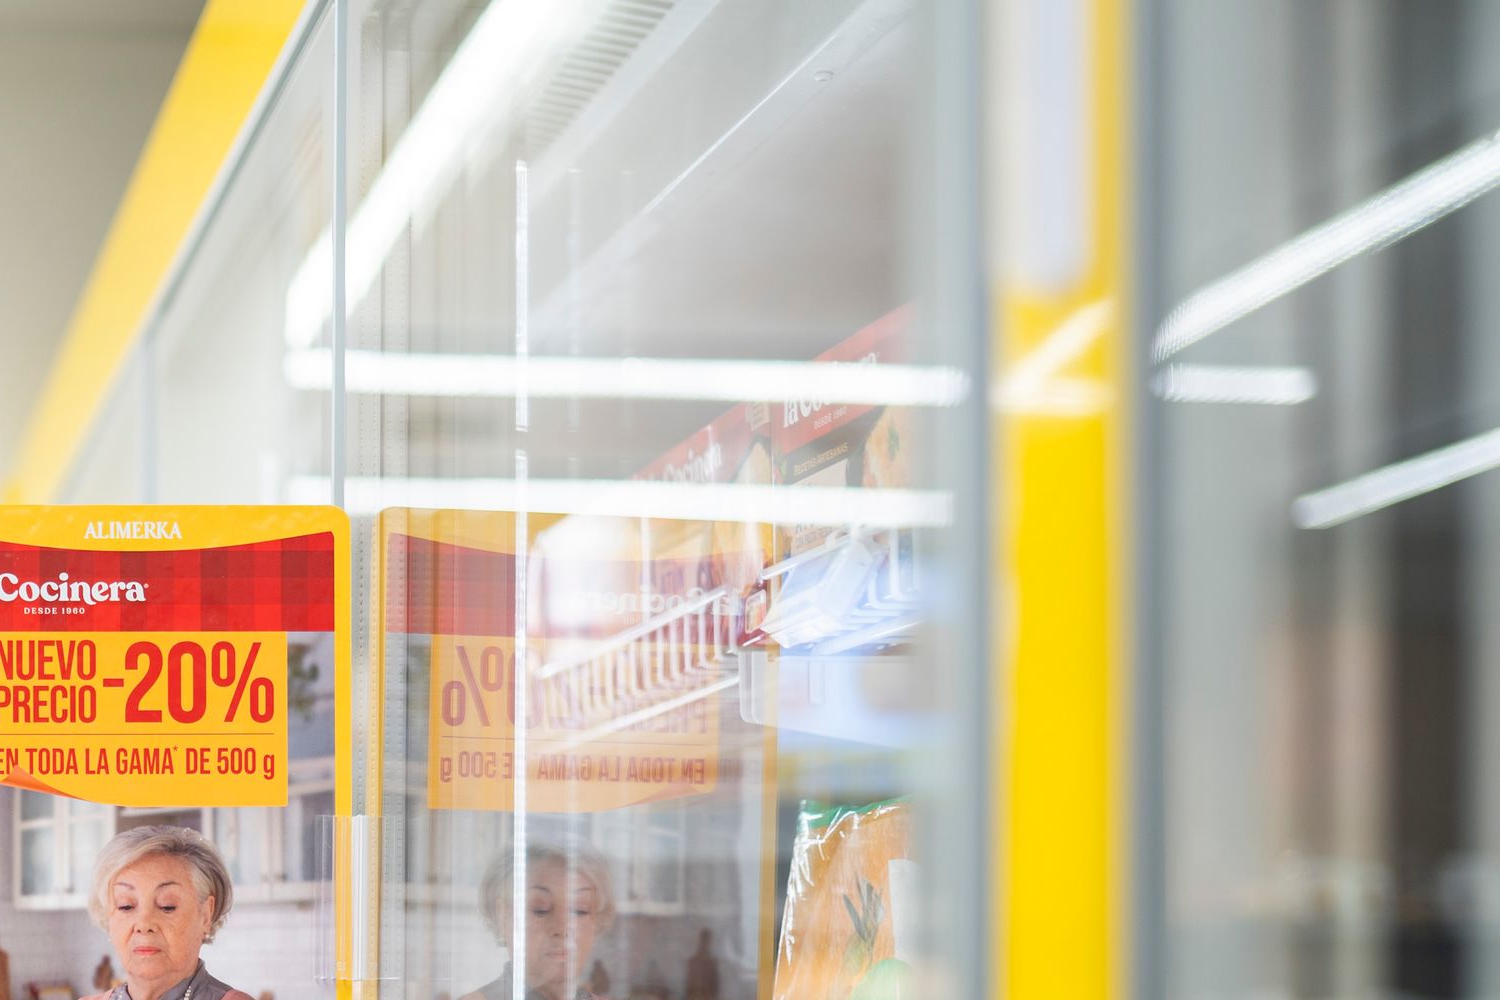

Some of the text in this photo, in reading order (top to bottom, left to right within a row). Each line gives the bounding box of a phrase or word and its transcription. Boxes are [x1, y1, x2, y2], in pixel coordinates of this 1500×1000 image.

[84, 521, 183, 540] ALIMERKA
[23, 607, 86, 615] DESDE 1960
[102, 640, 275, 724] -20%
[25, 747, 79, 775] TODA
[85, 747, 110, 775] LA
[185, 747, 211, 775] DE
[216, 747, 257, 775] 500
[263, 754, 275, 780] g
